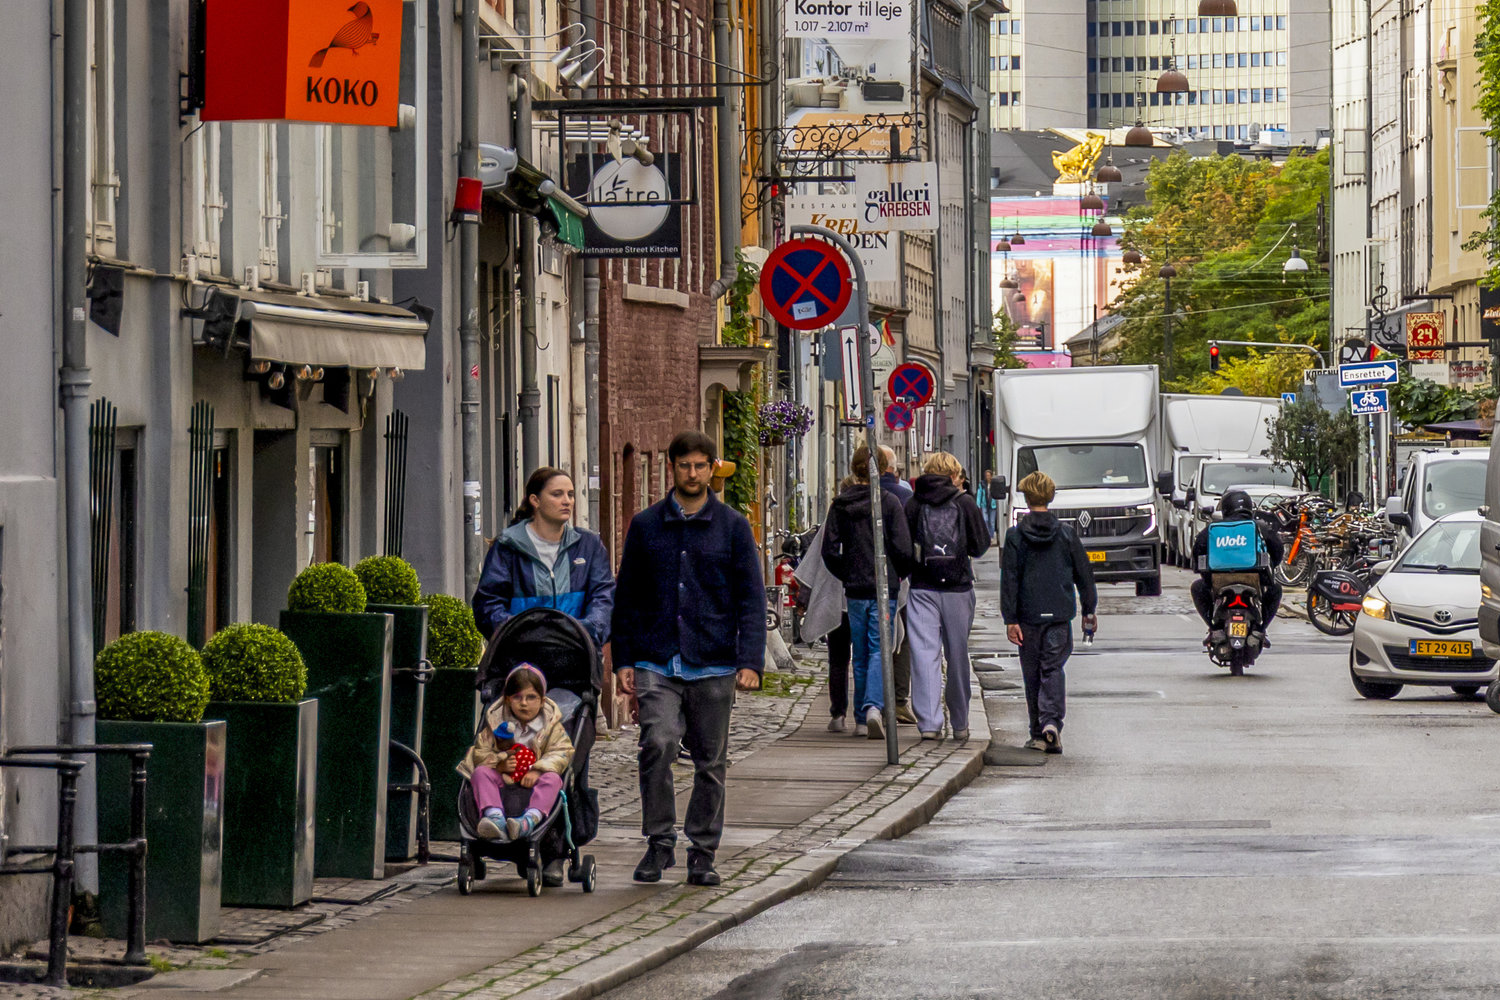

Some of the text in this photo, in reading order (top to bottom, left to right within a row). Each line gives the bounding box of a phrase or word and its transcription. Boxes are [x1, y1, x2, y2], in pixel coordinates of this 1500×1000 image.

[795, 0, 902, 20] Kontor til leje
[795, 21, 818, 32] 1.017
[854, 21, 869, 32] m²
[306, 76, 378, 106] KOKO
[865, 182, 929, 223] galleri
[880, 201, 931, 217] KREBSEN
[625, 245, 648, 253] Street
[650, 245, 678, 253] Kitchen
[1417, 328, 1432, 340] 24
[1344, 369, 1386, 380] Ensrettet
[1216, 534, 1247, 548] Wolt
[1417, 642, 1470, 654] ET 29 415
